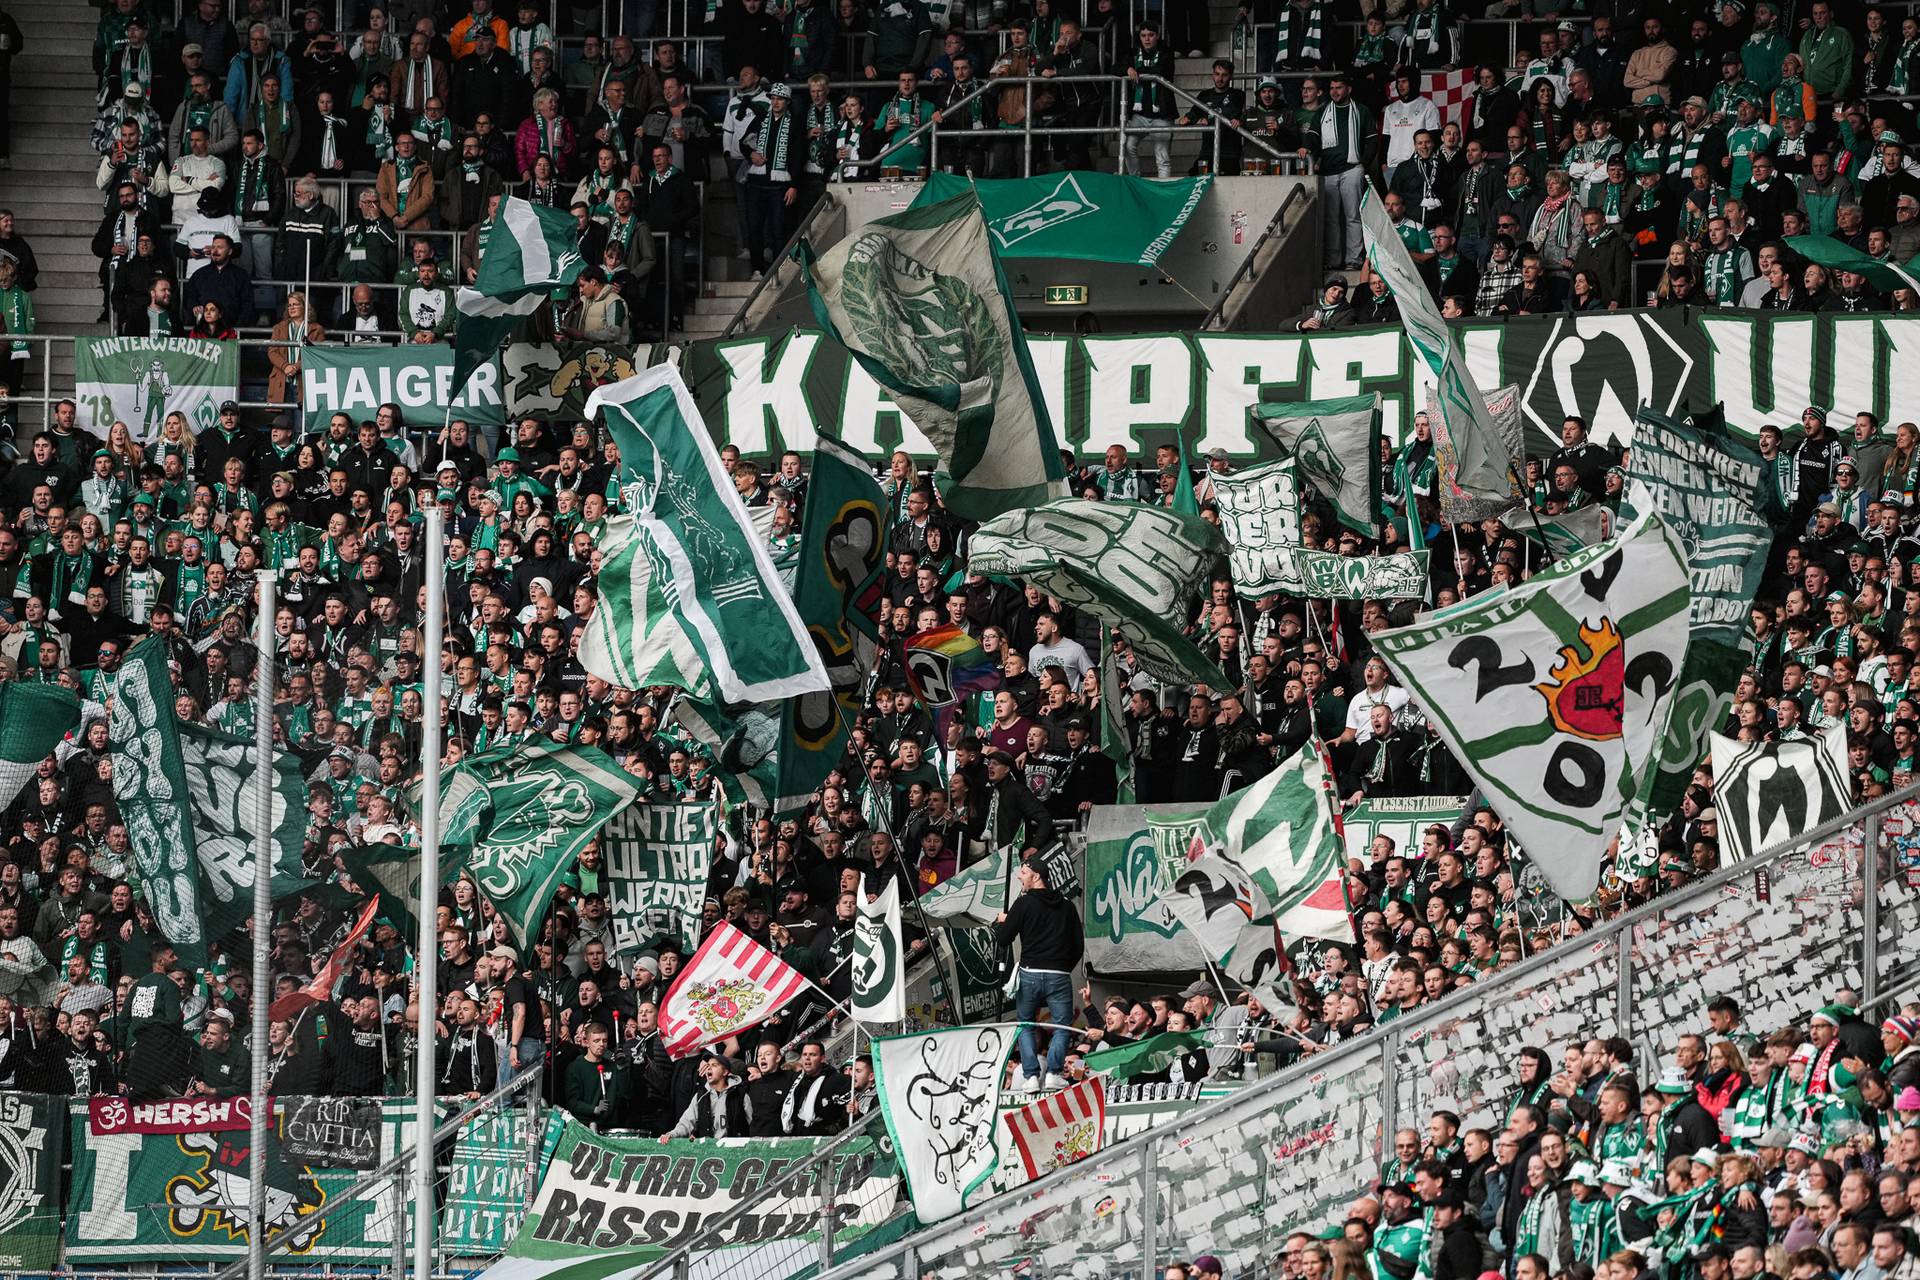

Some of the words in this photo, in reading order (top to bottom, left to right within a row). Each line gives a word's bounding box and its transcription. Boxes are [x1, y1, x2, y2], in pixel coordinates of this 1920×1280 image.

[1138, 227, 1180, 264] WERDER
[304, 362, 502, 413] HAIGER
[133, 1101, 231, 1125] HERSH
[287, 1121, 375, 1148] CIVETTA
[569, 1141, 726, 1200] ULTRAS
